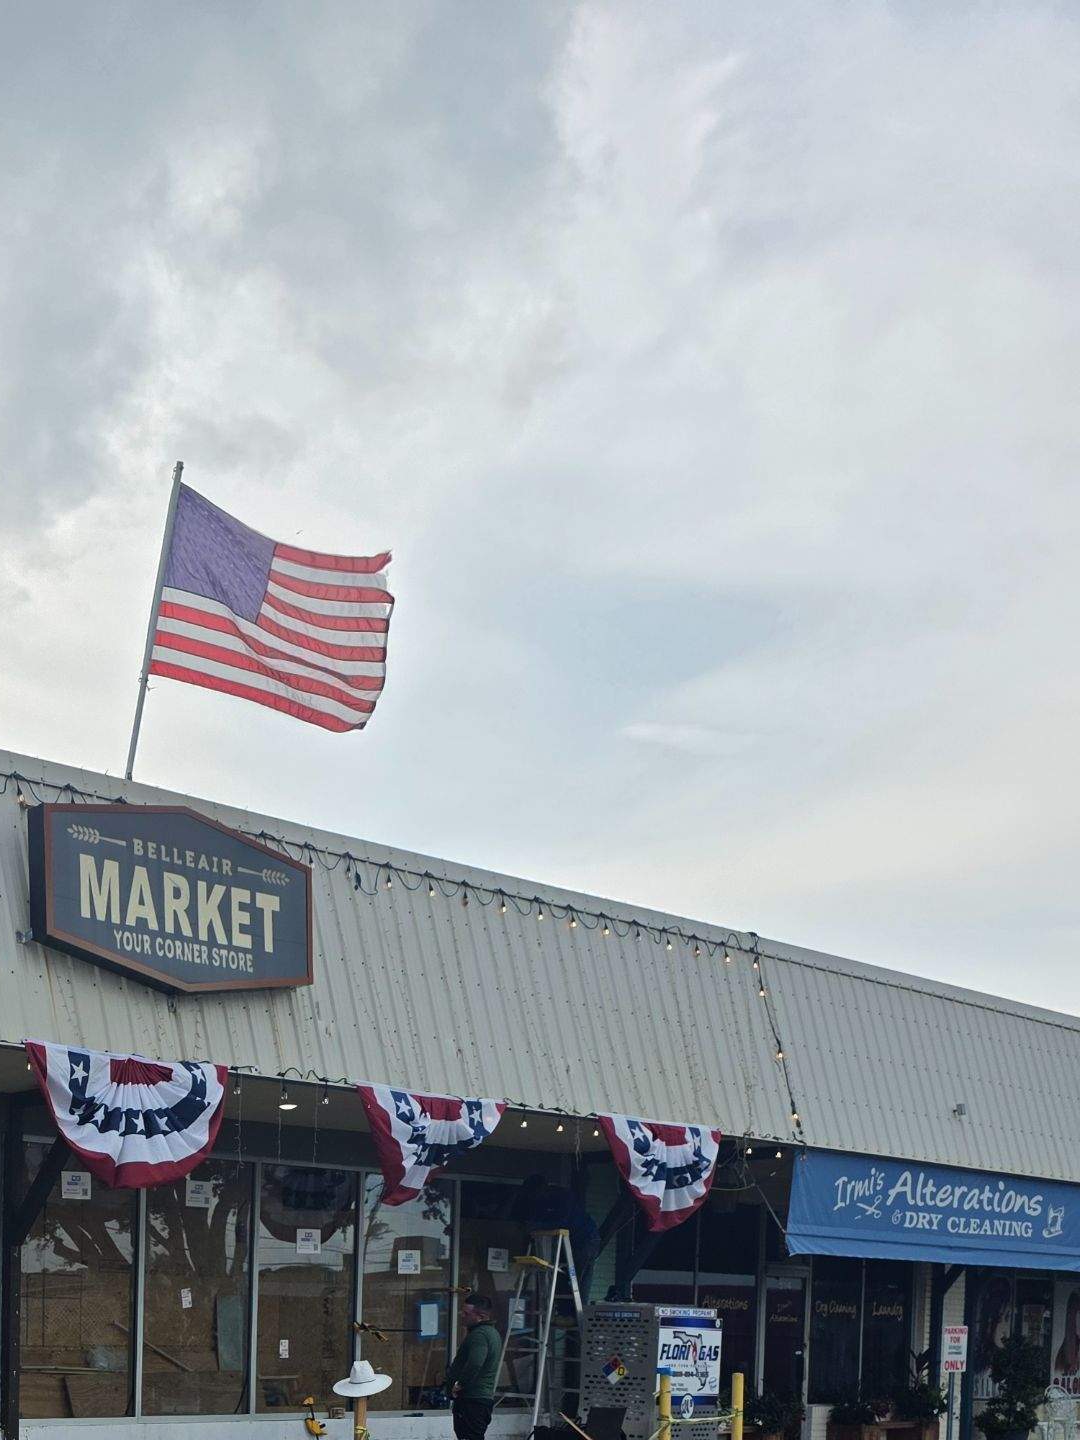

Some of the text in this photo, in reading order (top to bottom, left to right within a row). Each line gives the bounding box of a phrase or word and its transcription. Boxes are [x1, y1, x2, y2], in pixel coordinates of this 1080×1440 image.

[132, 838, 233, 877] BELLEAIR
[79, 853, 281, 953] MARKET
[113, 929, 254, 973] YOUR CORNER STORE
[833, 1167, 1044, 1216] Irmi's Alterations
[891, 1209, 1033, 1238] & DRY CLEANING
[944, 1327, 968, 1335] PARKING
[944, 1361, 965, 1371] ONLY
